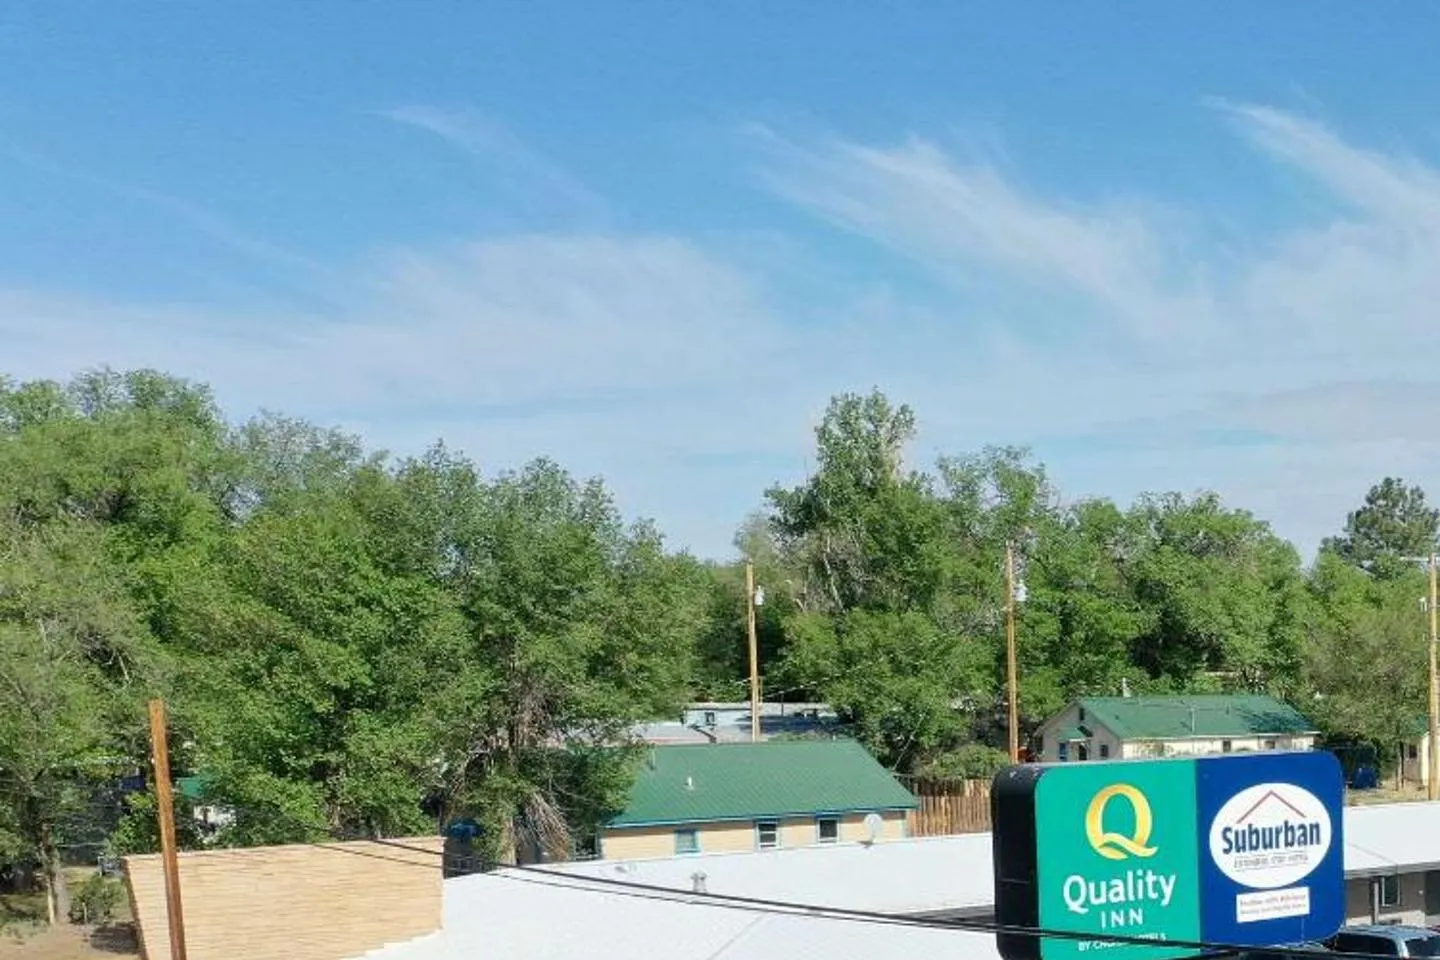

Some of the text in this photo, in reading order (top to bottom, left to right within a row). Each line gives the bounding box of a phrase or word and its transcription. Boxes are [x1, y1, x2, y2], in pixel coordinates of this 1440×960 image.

[1085, 783, 1159, 860] Q
[1222, 820, 1321, 854] Suburban
[1062, 869, 1176, 914] Quality
[1101, 907, 1144, 929] INN
